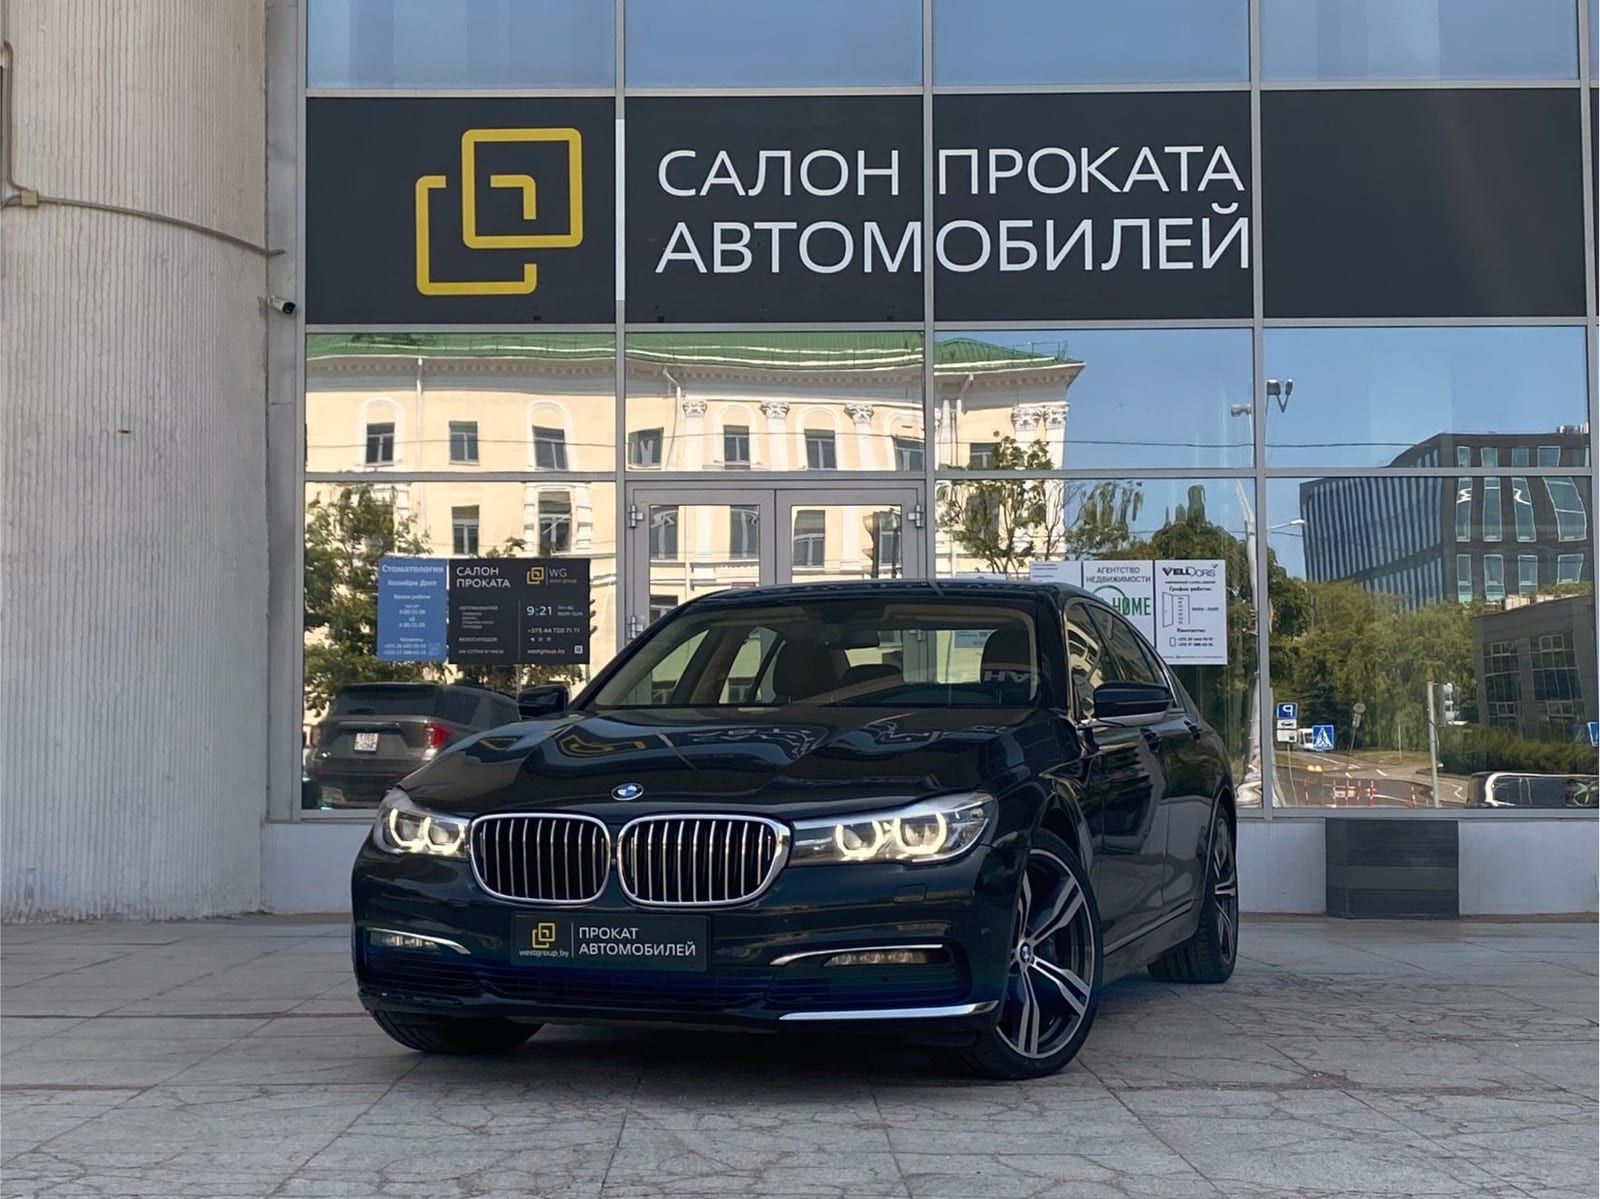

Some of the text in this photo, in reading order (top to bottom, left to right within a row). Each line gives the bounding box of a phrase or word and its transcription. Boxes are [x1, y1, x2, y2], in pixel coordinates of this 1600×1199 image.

[657, 145, 1246, 198] САЛОН ПРОКАТА
[655, 202, 1250, 275] АВТОМОБИЛЕЙ
[382, 564, 444, 574] Стоматология
[456, 566, 500, 577] САЛОН
[548, 568, 568, 578] WG
[1096, 566, 1141, 574] АГЕНТСТВО
[456, 578, 512, 588] ПРОКАТА
[1086, 575, 1152, 584] НЕДВИЖИМОСТИ
[579, 927, 639, 939] ПРОКАТ
[578, 941, 696, 956] АВТОМОБИЛЕЙ
